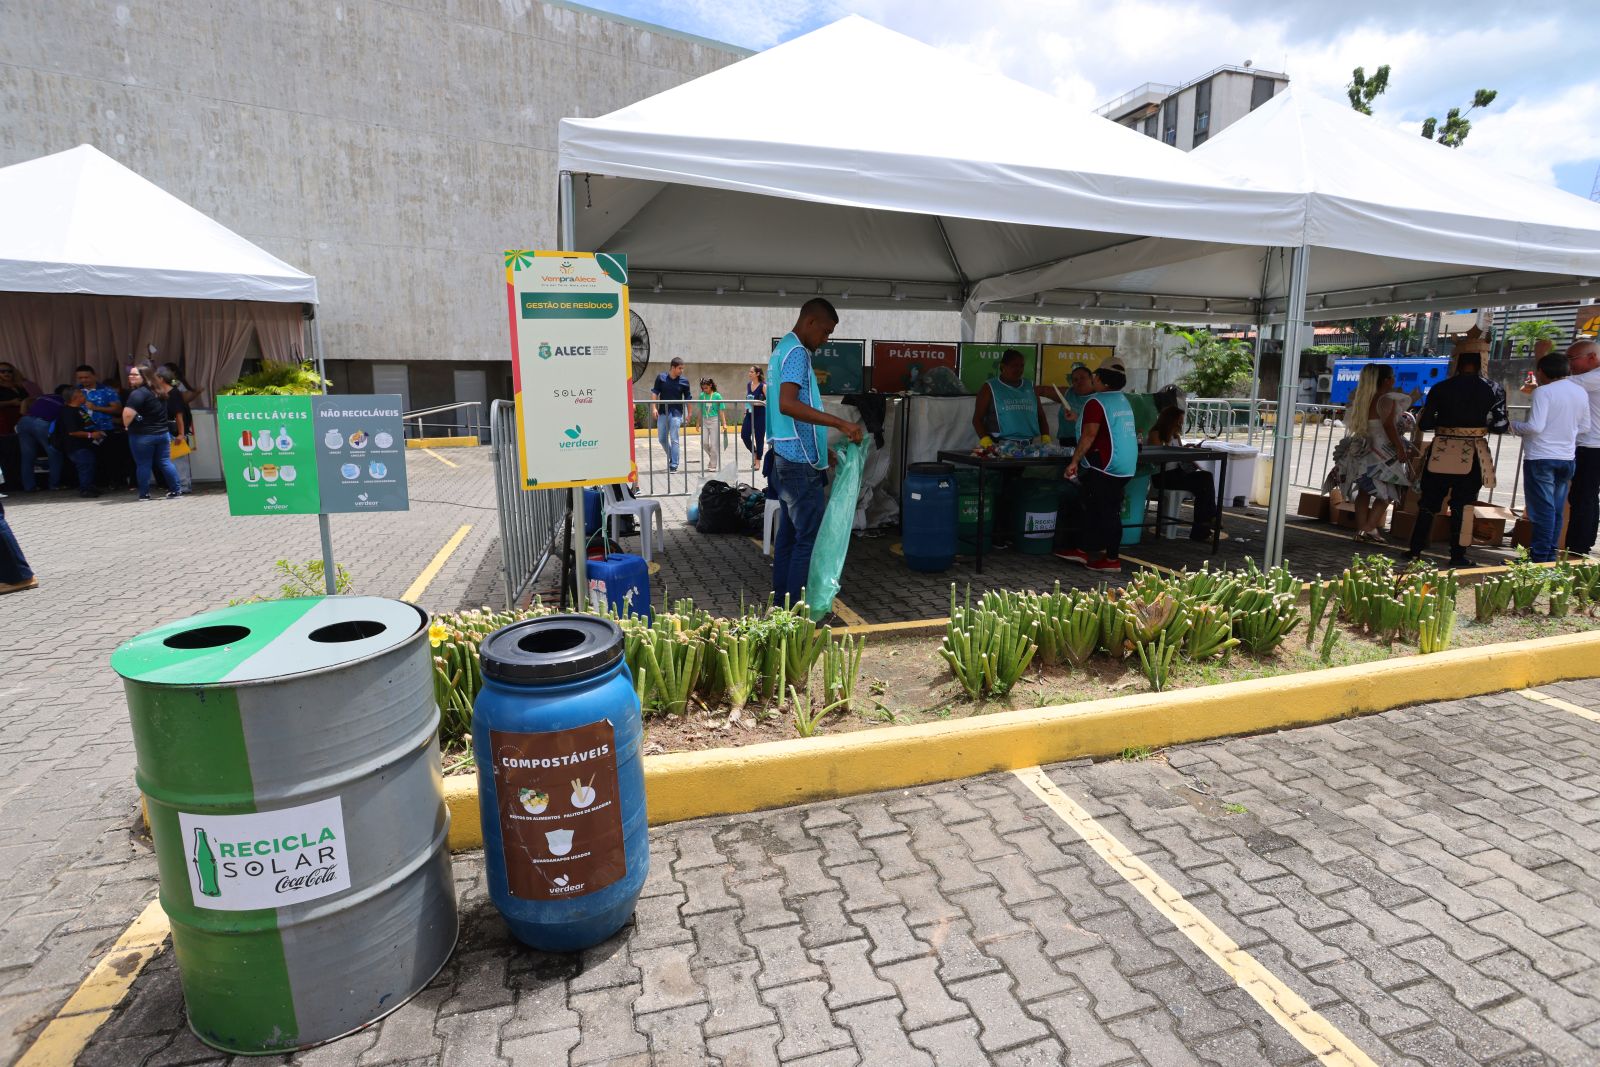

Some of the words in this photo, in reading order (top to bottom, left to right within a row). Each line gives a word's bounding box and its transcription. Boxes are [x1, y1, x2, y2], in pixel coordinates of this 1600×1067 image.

[526, 301, 560, 310] GESTÃO
[561, 302, 572, 310] DE
[573, 301, 614, 310] RESÍDUOS
[555, 346, 592, 356] ALECE
[889, 348, 945, 360] PLÁSTICO
[1058, 352, 1096, 361] METAL
[553, 389, 593, 398] SOLAR
[227, 410, 308, 420] RECICLÁVEIS
[320, 408, 341, 418] NÃO
[342, 408, 399, 417] RECICLÁVEIS
[559, 439, 599, 448] verdear
[502, 744, 609, 769] COMPOSTÁVEIS
[219, 826, 337, 858] RECICLA
[223, 846, 336, 878] SOLAR
[275, 863, 338, 893] Coca-Cola
[549, 883, 585, 894] verdear
